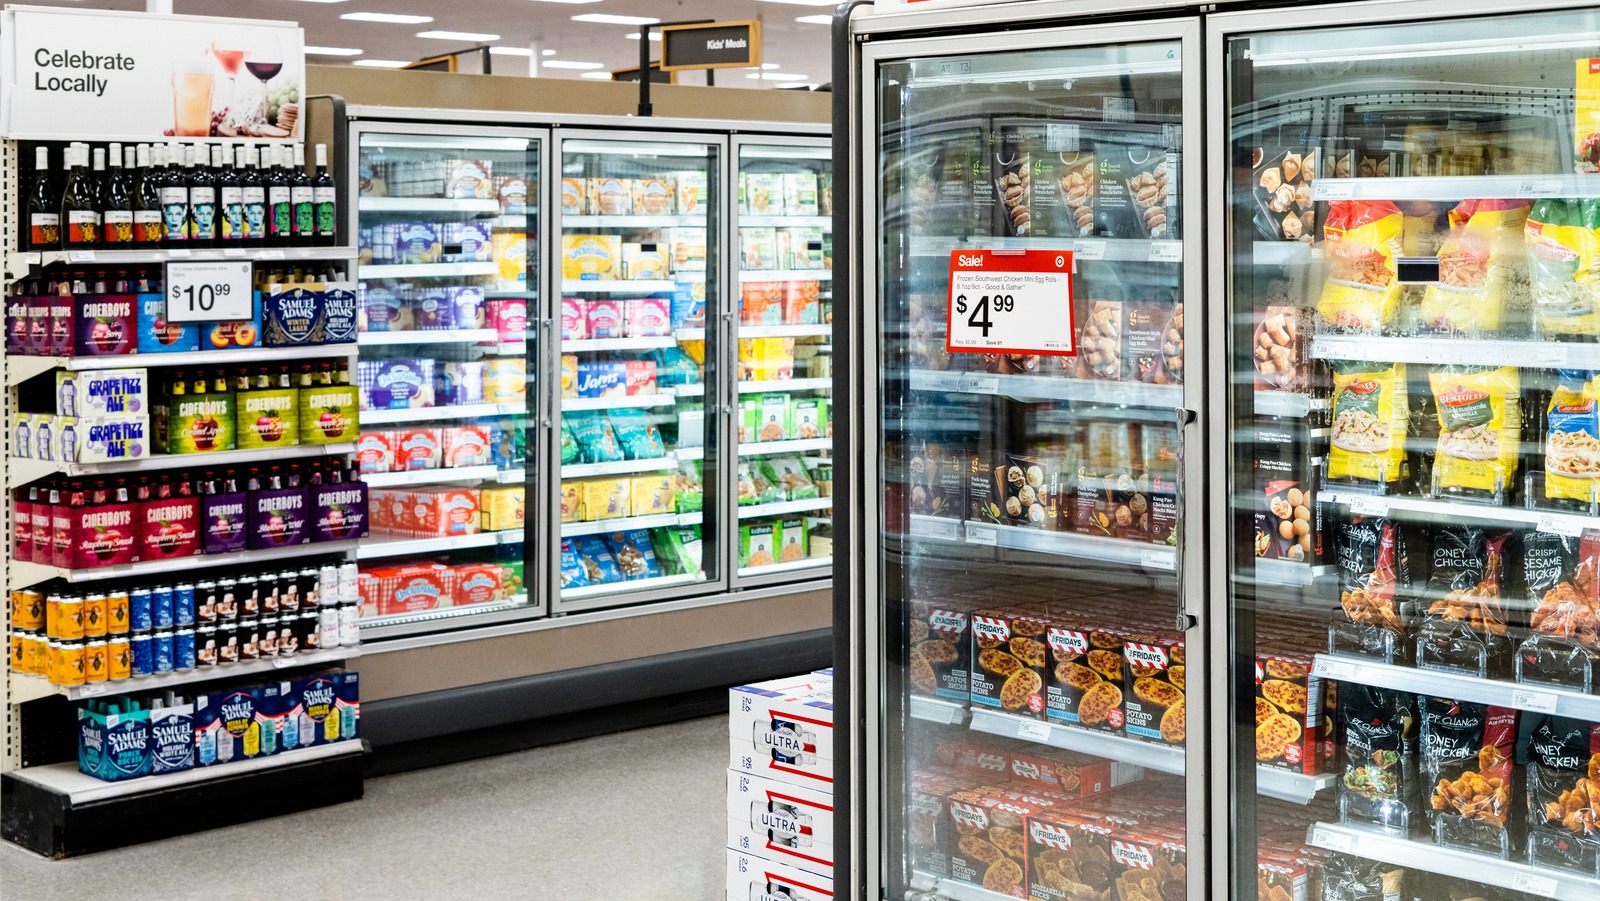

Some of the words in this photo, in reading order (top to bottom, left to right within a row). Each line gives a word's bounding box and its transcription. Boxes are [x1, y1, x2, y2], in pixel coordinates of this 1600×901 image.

[706, 40, 724, 49] Kids'
[725, 38, 746, 48] Meals
[34, 48, 135, 70] Celebrate
[35, 72, 108, 96] Locally
[958, 255, 983, 267] Sale!
[83, 302, 130, 318] CIDERBOYS
[278, 298, 317, 311] SAMUEL
[325, 299, 356, 310] SAMUEL
[282, 308, 314, 320] ADAMS
[325, 308, 354, 318] ADAMS
[579, 373, 619, 392] Jams
[626, 371, 650, 386] ams
[89, 378, 120, 396] GRAPE
[122, 377, 141, 395] FIZZ
[106, 396, 124, 412] ALE
[246, 396, 291, 412] CIDERBOYS
[309, 393, 352, 408] CIDERBOYS
[179, 400, 227, 417] CIDERBOYS
[90, 423, 121, 442] GRAPE
[122, 422, 143, 439] FIZZ
[107, 440, 125, 457] ALE
[258, 495, 302, 512] CIDERBOYS
[318, 490, 362, 506] CIDERBOYS
[147, 505, 193, 523] CIDERBOYS
[209, 504, 243, 517] CIDERBOYS
[82, 511, 131, 528] CIDERBOYS
[751, 526, 772, 535] kidfresh
[79, 540, 112, 551] Raspberry
[145, 534, 178, 545] Raspberry
[1528, 549, 1557, 557] CRISPY
[1435, 559, 1482, 568] CHICKEN
[1524, 556, 1562, 569] SESAME
[979, 624, 1004, 635] FRIDAYS
[1055, 636, 1081, 647] FRIDAYS
[1132, 651, 1161, 662] FRIDAYS
[972, 680, 994, 690] POTATO
[972, 687, 988, 695] SKINS
[303, 687, 335, 700] SAMUEL
[1048, 694, 1071, 704] POTATO
[221, 701, 254, 715] SAMUEL
[306, 696, 332, 707] ADAMS
[1048, 701, 1066, 710] SKINS
[224, 710, 251, 722] ADAMS
[1127, 710, 1152, 720] POTATO
[1127, 717, 1146, 726] SKINS
[108, 728, 149, 745] SAMUEL
[152, 723, 193, 739] SAMUEL
[112, 740, 146, 754] ADAMS
[157, 734, 190, 747] ADAMS
[765, 733, 800, 751] ULTRA
[958, 810, 983, 822] FRIDAYS
[761, 813, 796, 833] ULTRA
[1038, 830, 1066, 843] FRIDAYS
[1119, 850, 1148, 863] FRIDAYS
[952, 865, 976, 875] POTATO
[952, 871, 971, 880] SKINS
[1031, 883, 1066, 898] MOZZARELLA
[1031, 891, 1050, 900] STICKS
